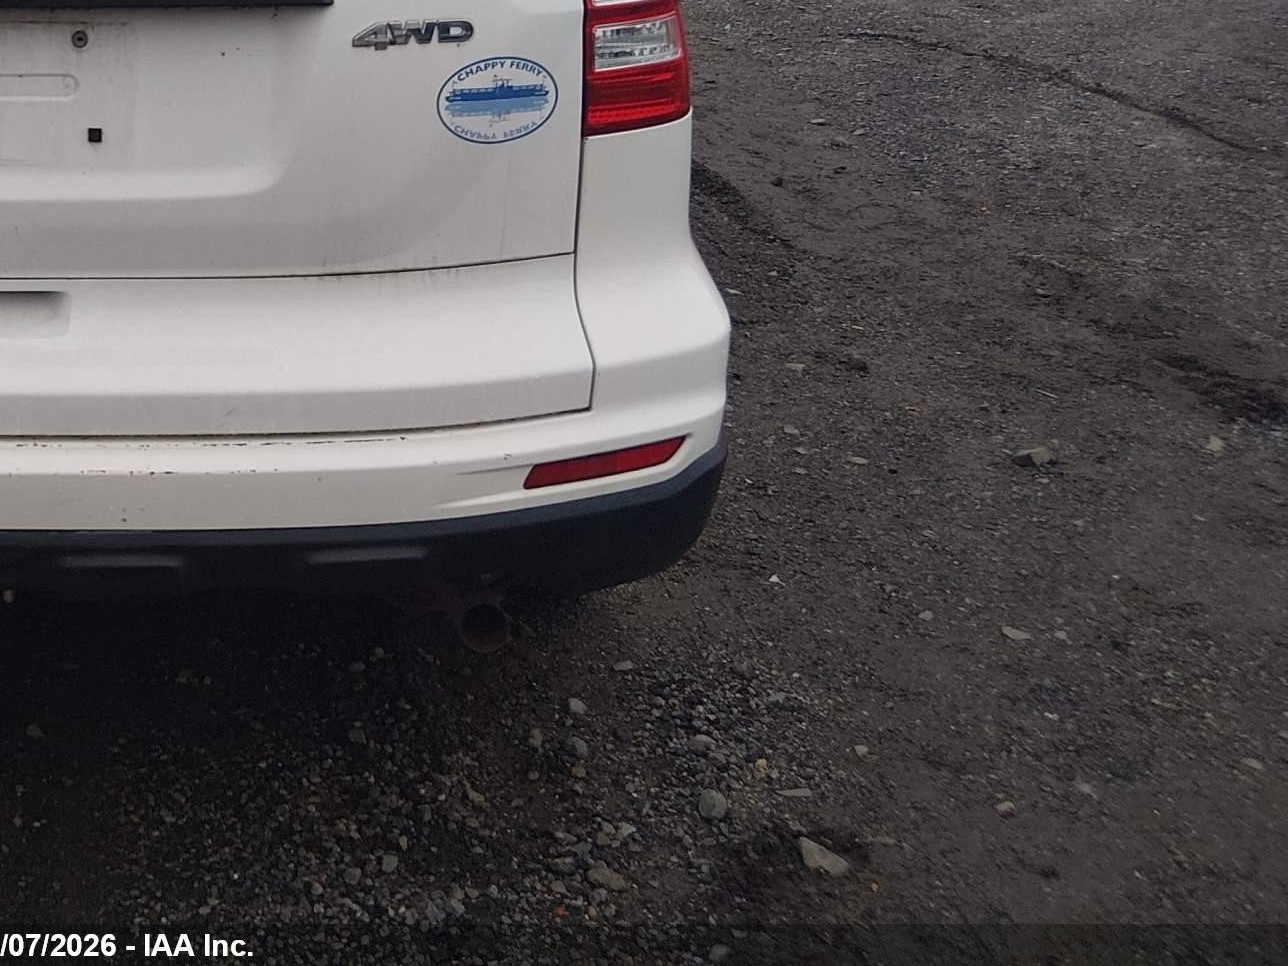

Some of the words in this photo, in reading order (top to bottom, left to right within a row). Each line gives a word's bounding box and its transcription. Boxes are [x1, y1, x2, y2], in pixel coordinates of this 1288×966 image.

[352, 19, 474, 51] 4WD
[456, 60, 507, 82] CHAPPY
[509, 60, 544, 77] FERRY
